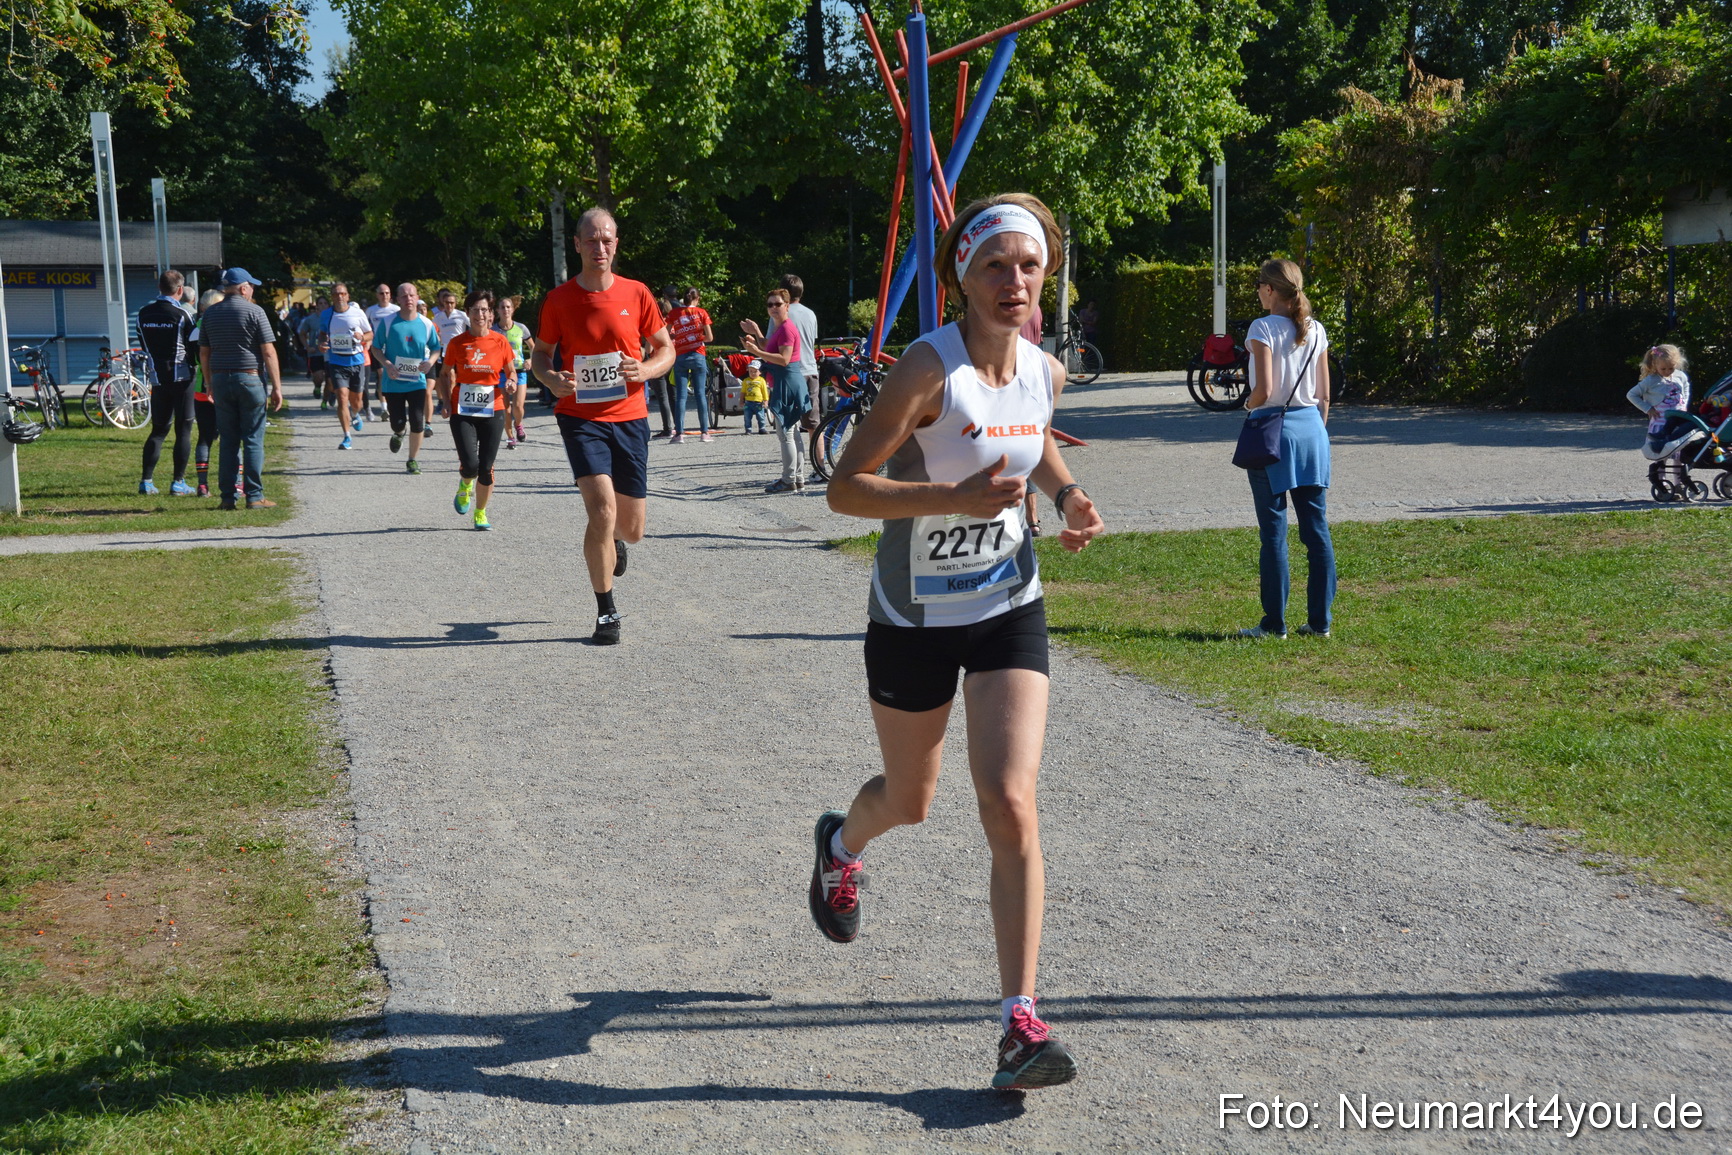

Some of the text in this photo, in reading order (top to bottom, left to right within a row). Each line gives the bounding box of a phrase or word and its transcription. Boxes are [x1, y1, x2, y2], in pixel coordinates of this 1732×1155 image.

[46, 272, 92, 285] KIOSK
[581, 366, 617, 383] 3125
[464, 392, 490, 404] 2182
[986, 424, 1041, 438] KLEBL
[927, 519, 1005, 560] 2277
[962, 558, 995, 570] Neumarkt
